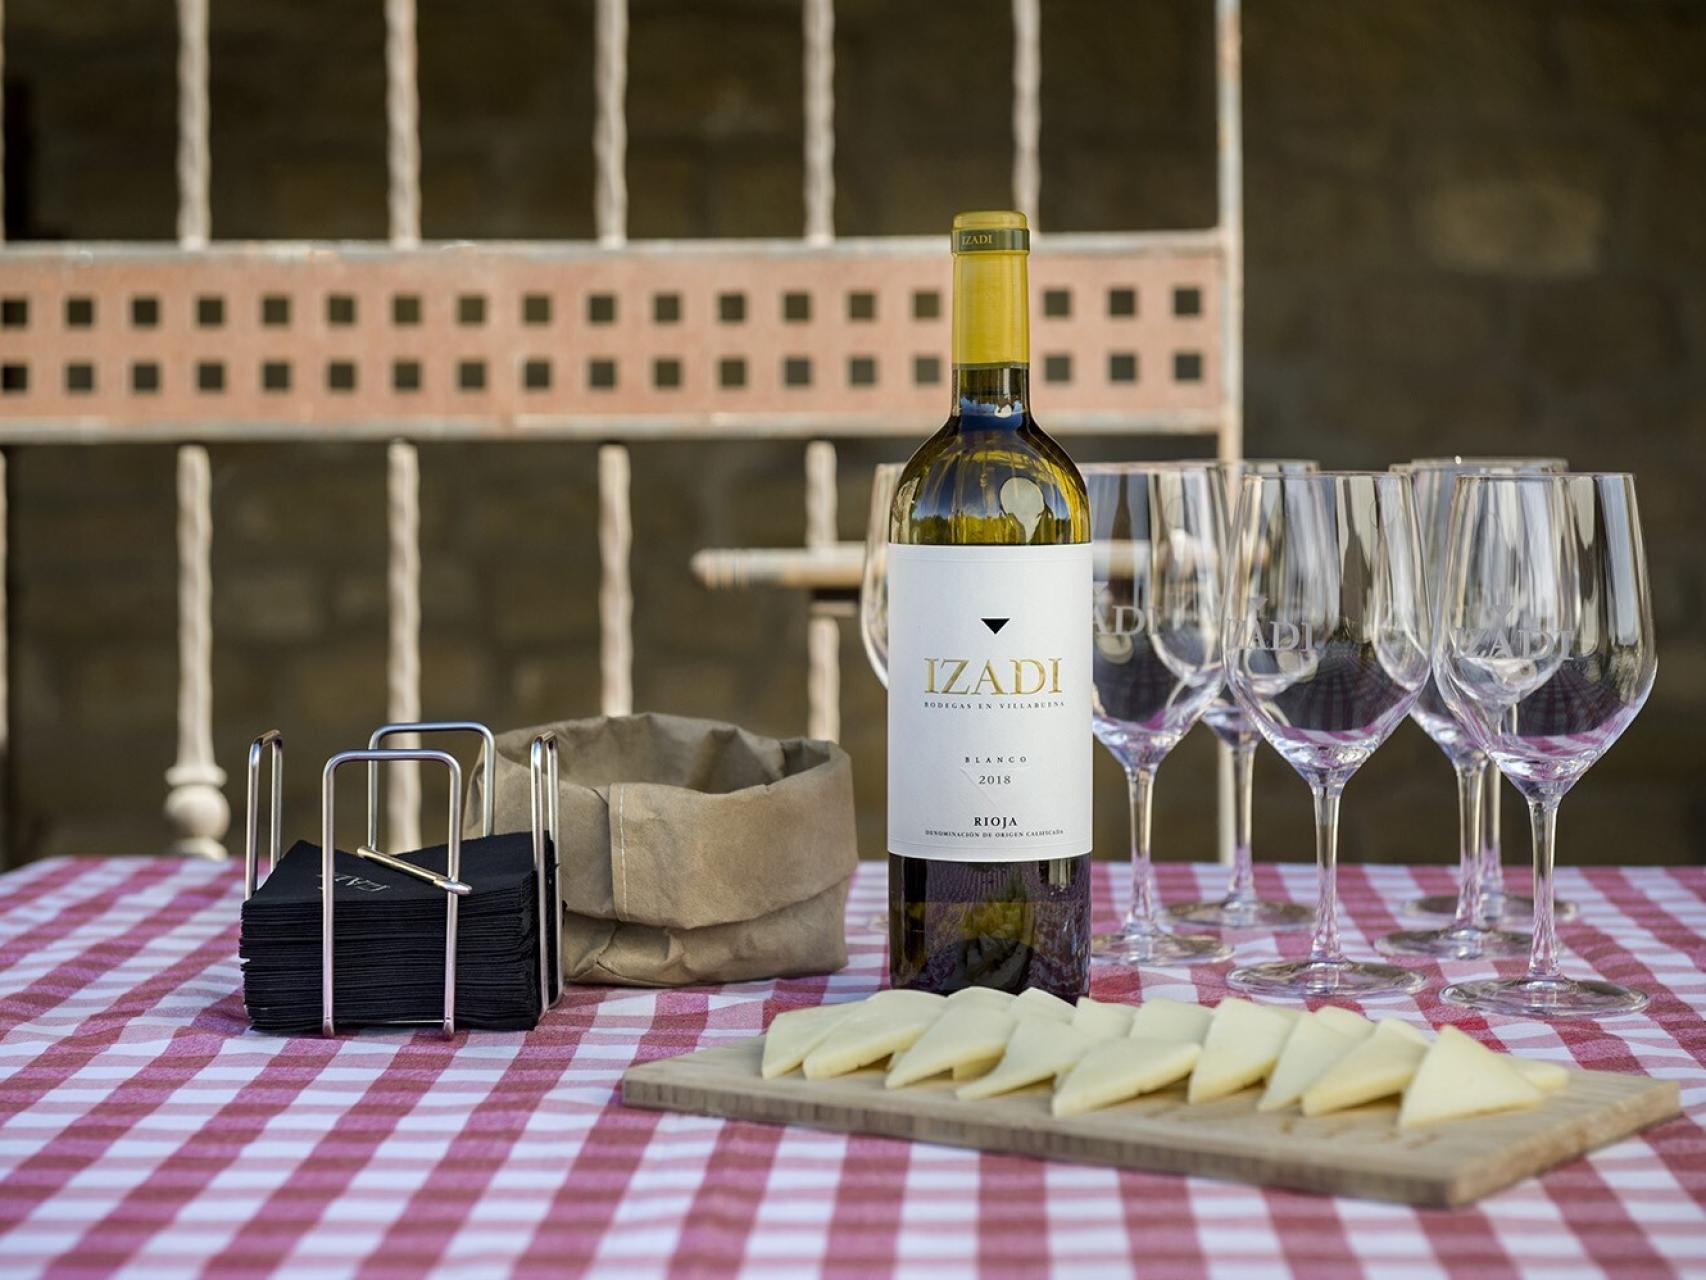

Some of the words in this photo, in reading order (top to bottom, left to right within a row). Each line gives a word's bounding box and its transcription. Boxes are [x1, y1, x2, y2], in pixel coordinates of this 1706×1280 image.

[962, 234, 993, 246] IZADI
[924, 657, 1063, 696] IZADI
[924, 701, 972, 710] BODEGAS
[978, 702, 992, 710] EN
[999, 701, 1065, 710] VILLABUENA
[964, 756, 1028, 765] BLANCO
[978, 775, 1012, 786] 2018
[974, 816, 1018, 830] RIOJA
[982, 831, 992, 839] DE
[994, 830, 1024, 839] ORIGEN
